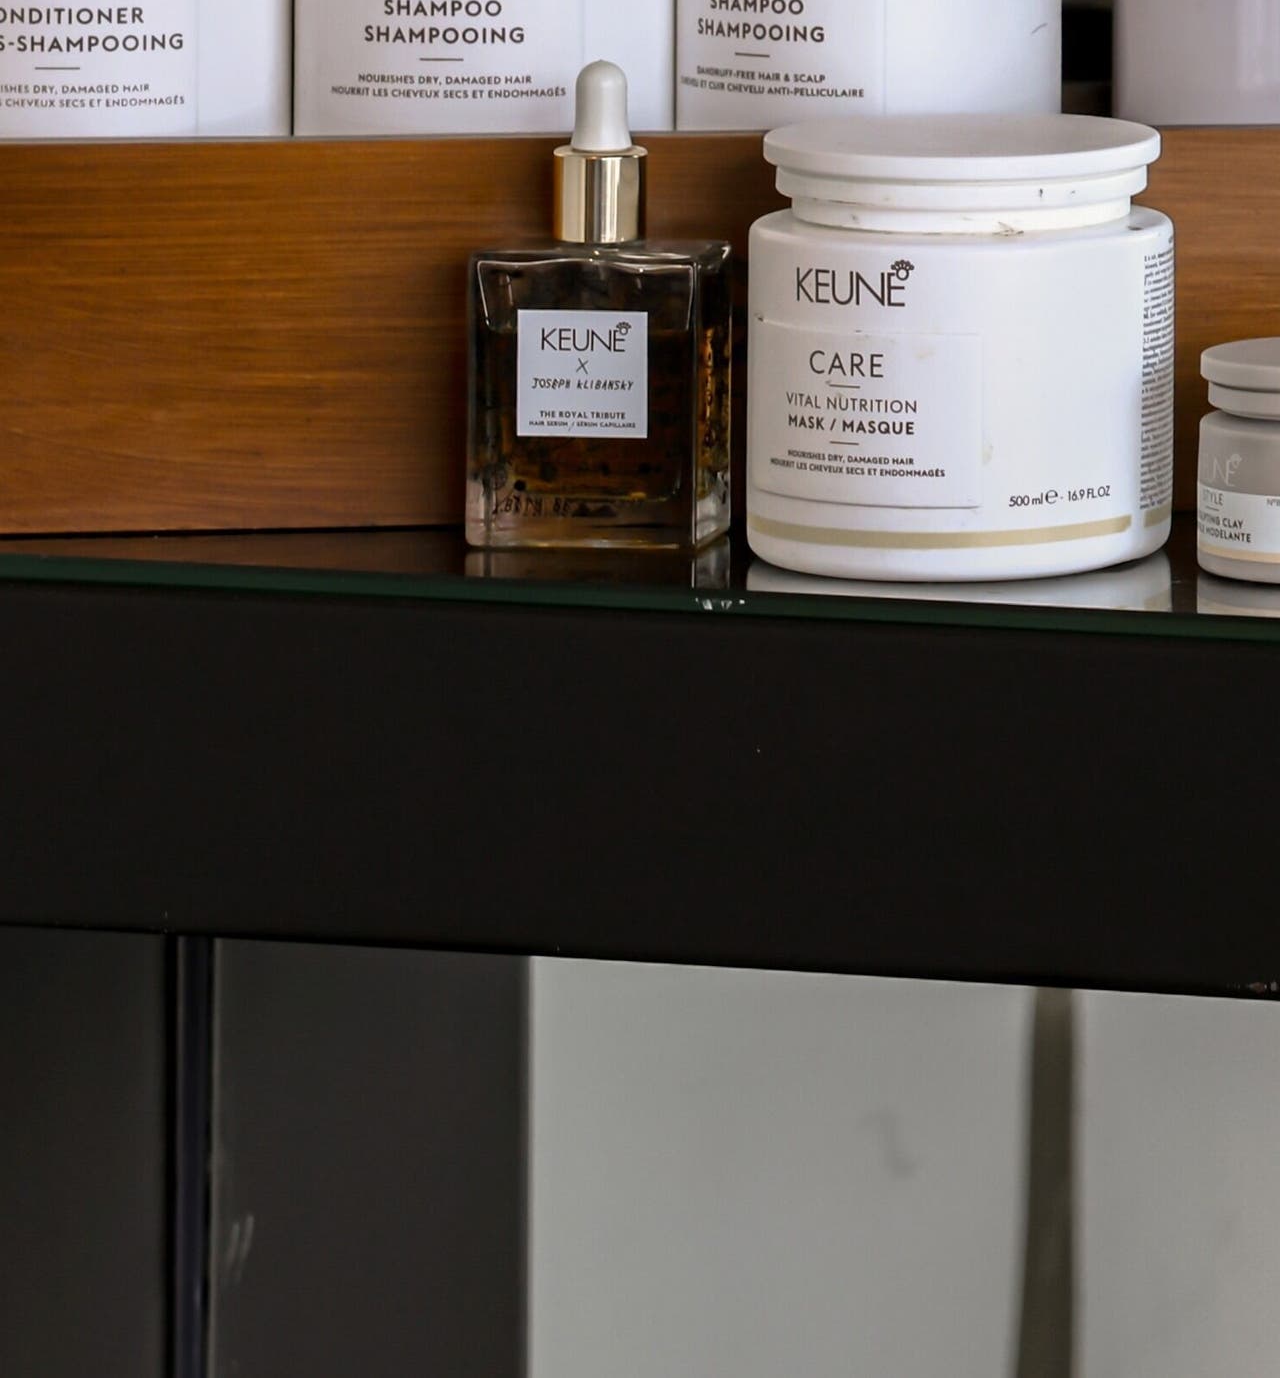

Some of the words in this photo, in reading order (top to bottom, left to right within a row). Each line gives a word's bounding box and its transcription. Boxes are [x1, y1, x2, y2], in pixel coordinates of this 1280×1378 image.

[0, 6, 144, 24] NDITIONER
[364, 25, 525, 44] SHAMPOOING
[697, 18, 825, 42] SHAMPOOING
[358, 73, 415, 84] NOURISHES
[418, 74, 442, 86] DRY,
[445, 75, 501, 85] DAMAGED
[504, 74, 532, 84] HAIR
[758, 73, 781, 82] HAIR
[794, 74, 825, 83] SCALP
[33, 84, 58, 96] DRY,
[62, 84, 119, 94] DAMAGED
[122, 83, 150, 92] HAIR
[372, 88, 388, 98] LES
[391, 88, 439, 99] CHEVEUX
[443, 89, 468, 99] SECS
[472, 89, 483, 99] ET
[487, 86, 566, 99] ENDOMMAGÉS
[727, 82, 764, 94] CHEVELU
[767, 87, 864, 98] ANTI-PELLICULAIRE
[5, 98, 55, 108] CHEVEUX
[59, 98, 85, 108] SECS
[89, 99, 101, 108] ET
[797, 267, 905, 307] KEUNE
[541, 327, 625, 352] KEUNE
[809, 350, 884, 378] CARE
[786, 392, 821, 410] VITAL
[827, 396, 917, 414] NUTRITION
[540, 410, 556, 419] THE
[559, 410, 588, 419] ROYAL
[591, 411, 626, 420] TRIBUTE
[788, 414, 825, 431] MASK
[842, 419, 915, 435] MASQUE
[848, 455, 889, 465] DAMAGED
[892, 457, 914, 465] HAIR
[809, 463, 843, 474] CHEVEUX
[846, 466, 865, 476] SECS
[868, 468, 877, 476] ET
[1009, 494, 1030, 507] 500
[1222, 517, 1243, 530] CLAY
